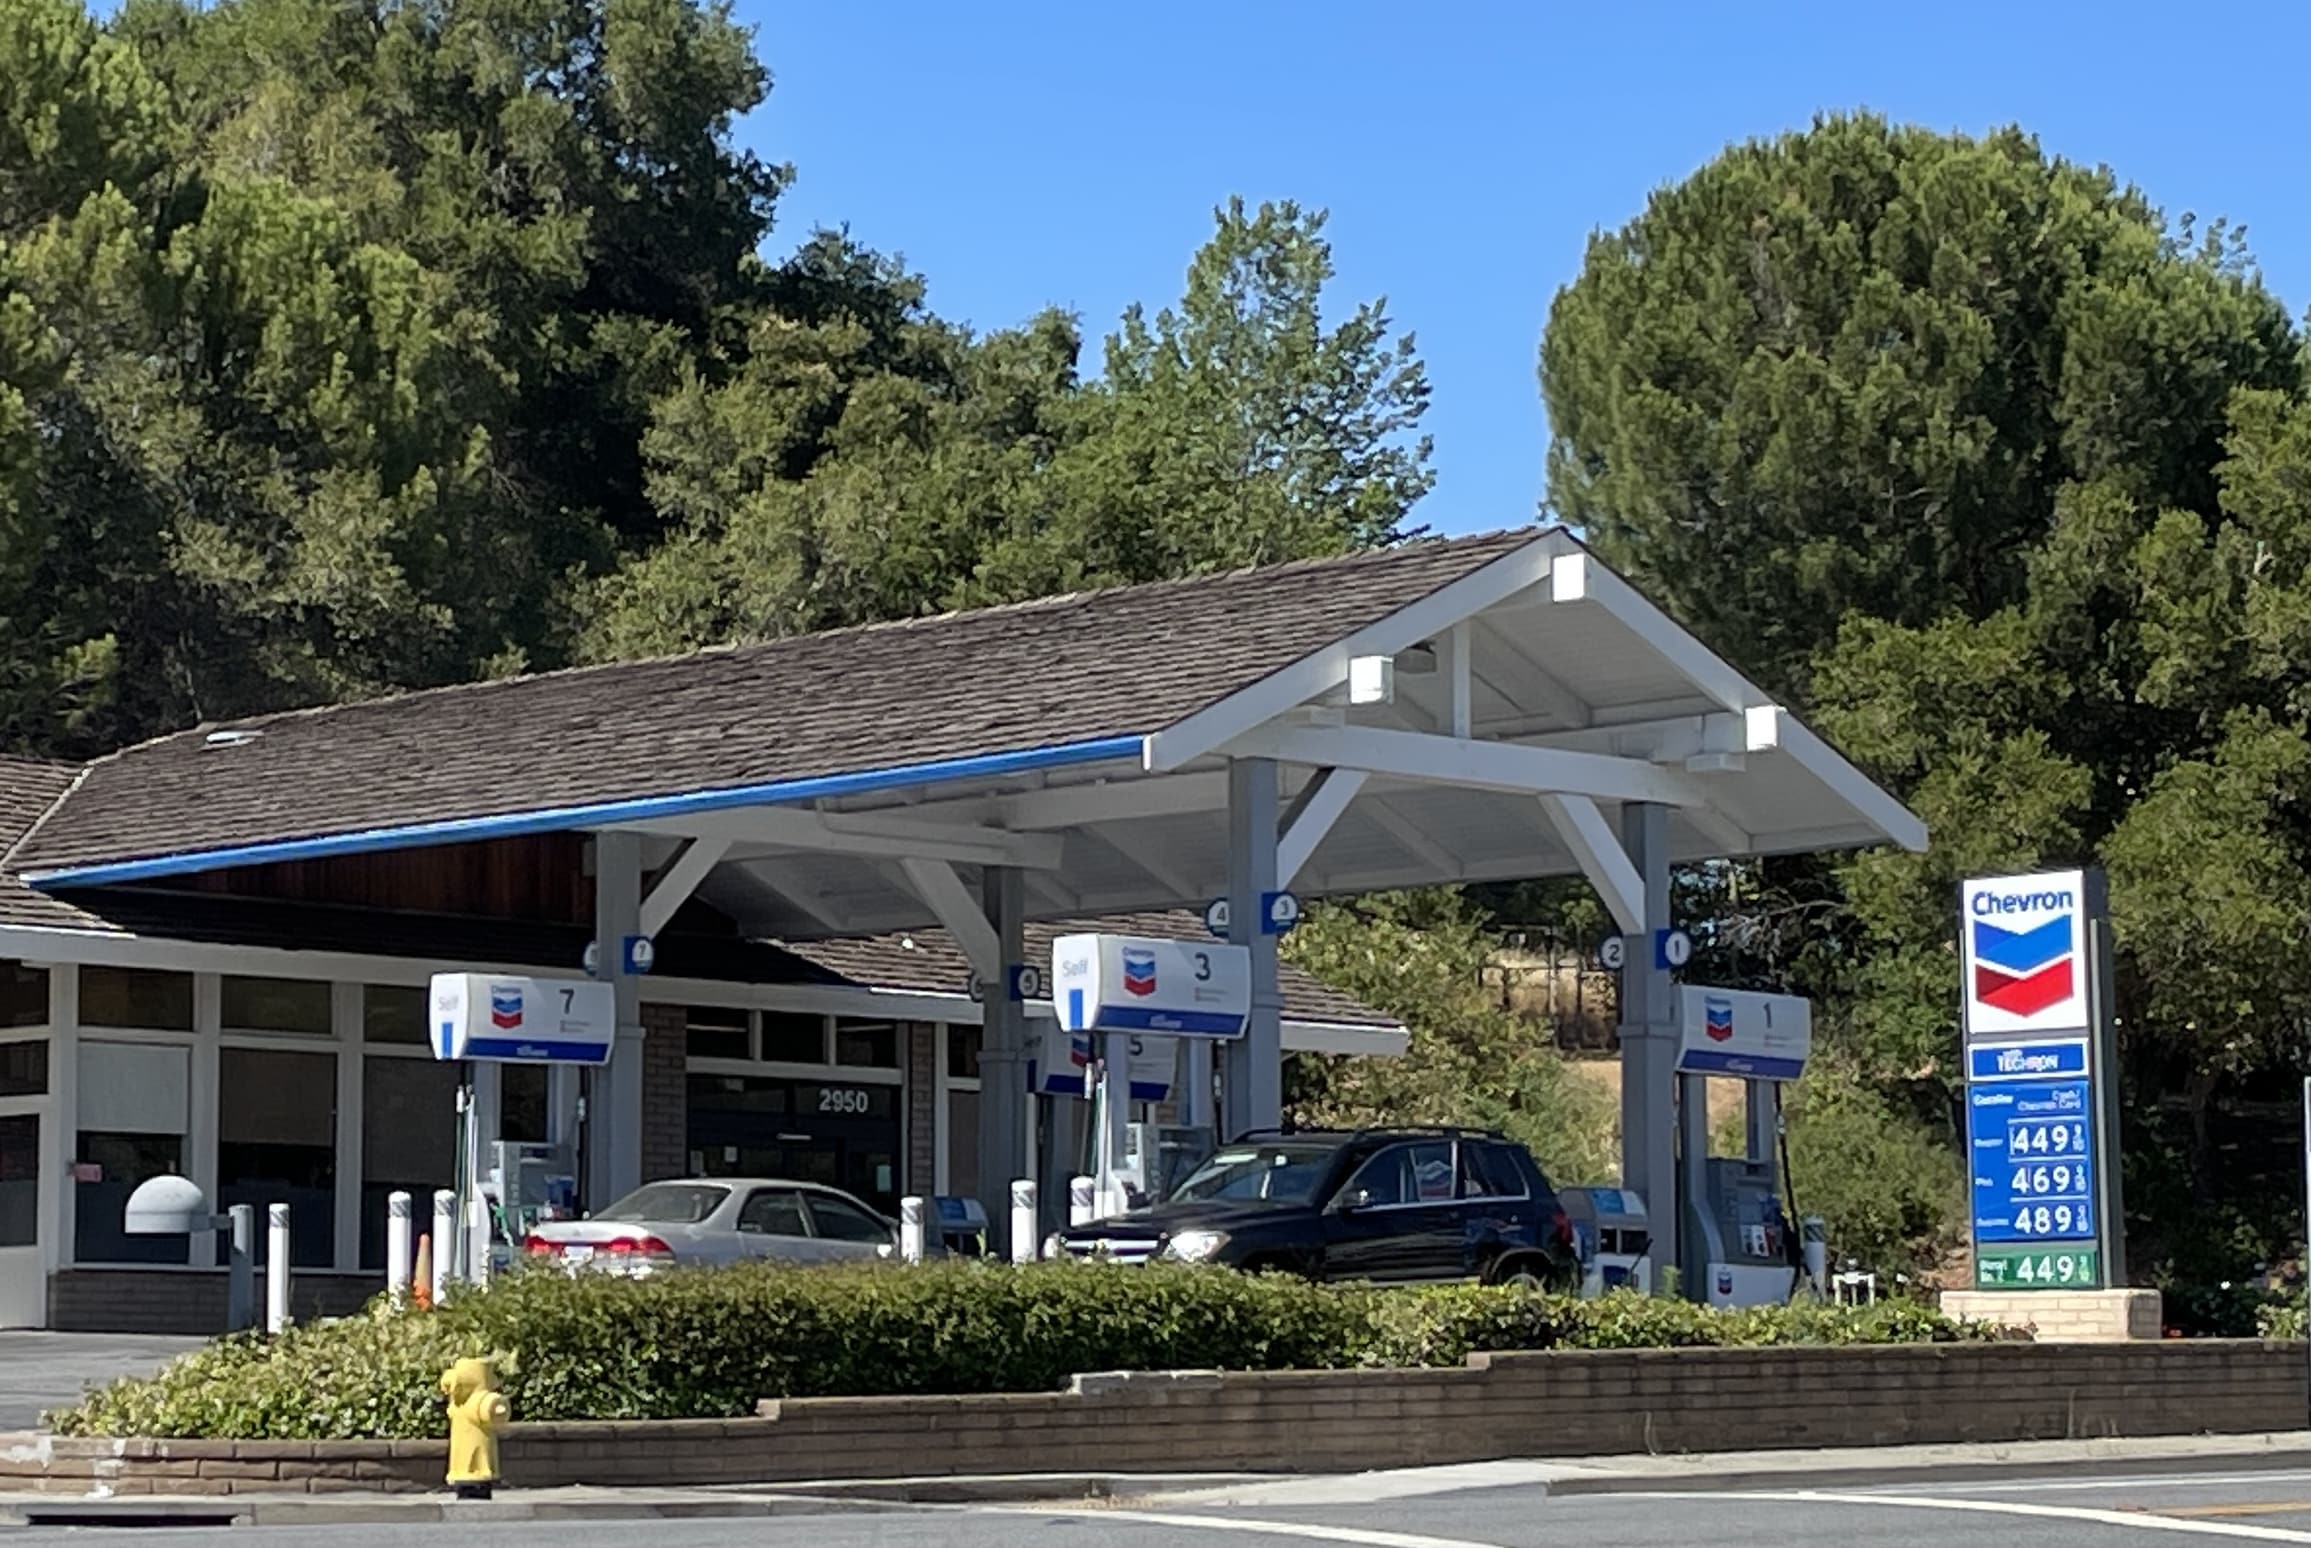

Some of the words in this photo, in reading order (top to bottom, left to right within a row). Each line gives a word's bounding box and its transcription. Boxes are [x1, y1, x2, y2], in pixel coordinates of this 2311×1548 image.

[1971, 891, 2074, 916] Chevron
[1608, 943, 1621, 962] 2
[1194, 952, 1211, 982] 3
[558, 988, 575, 1015] 7
[1763, 1002, 1773, 1029] 1
[1128, 1034, 1144, 1056] 5
[819, 1088, 869, 1112] 2950
[2013, 1124, 2069, 1154] 449
[2011, 1165, 2070, 1194] 469
[2014, 1205, 2072, 1234] 489
[2016, 1255, 2075, 1283] 449
